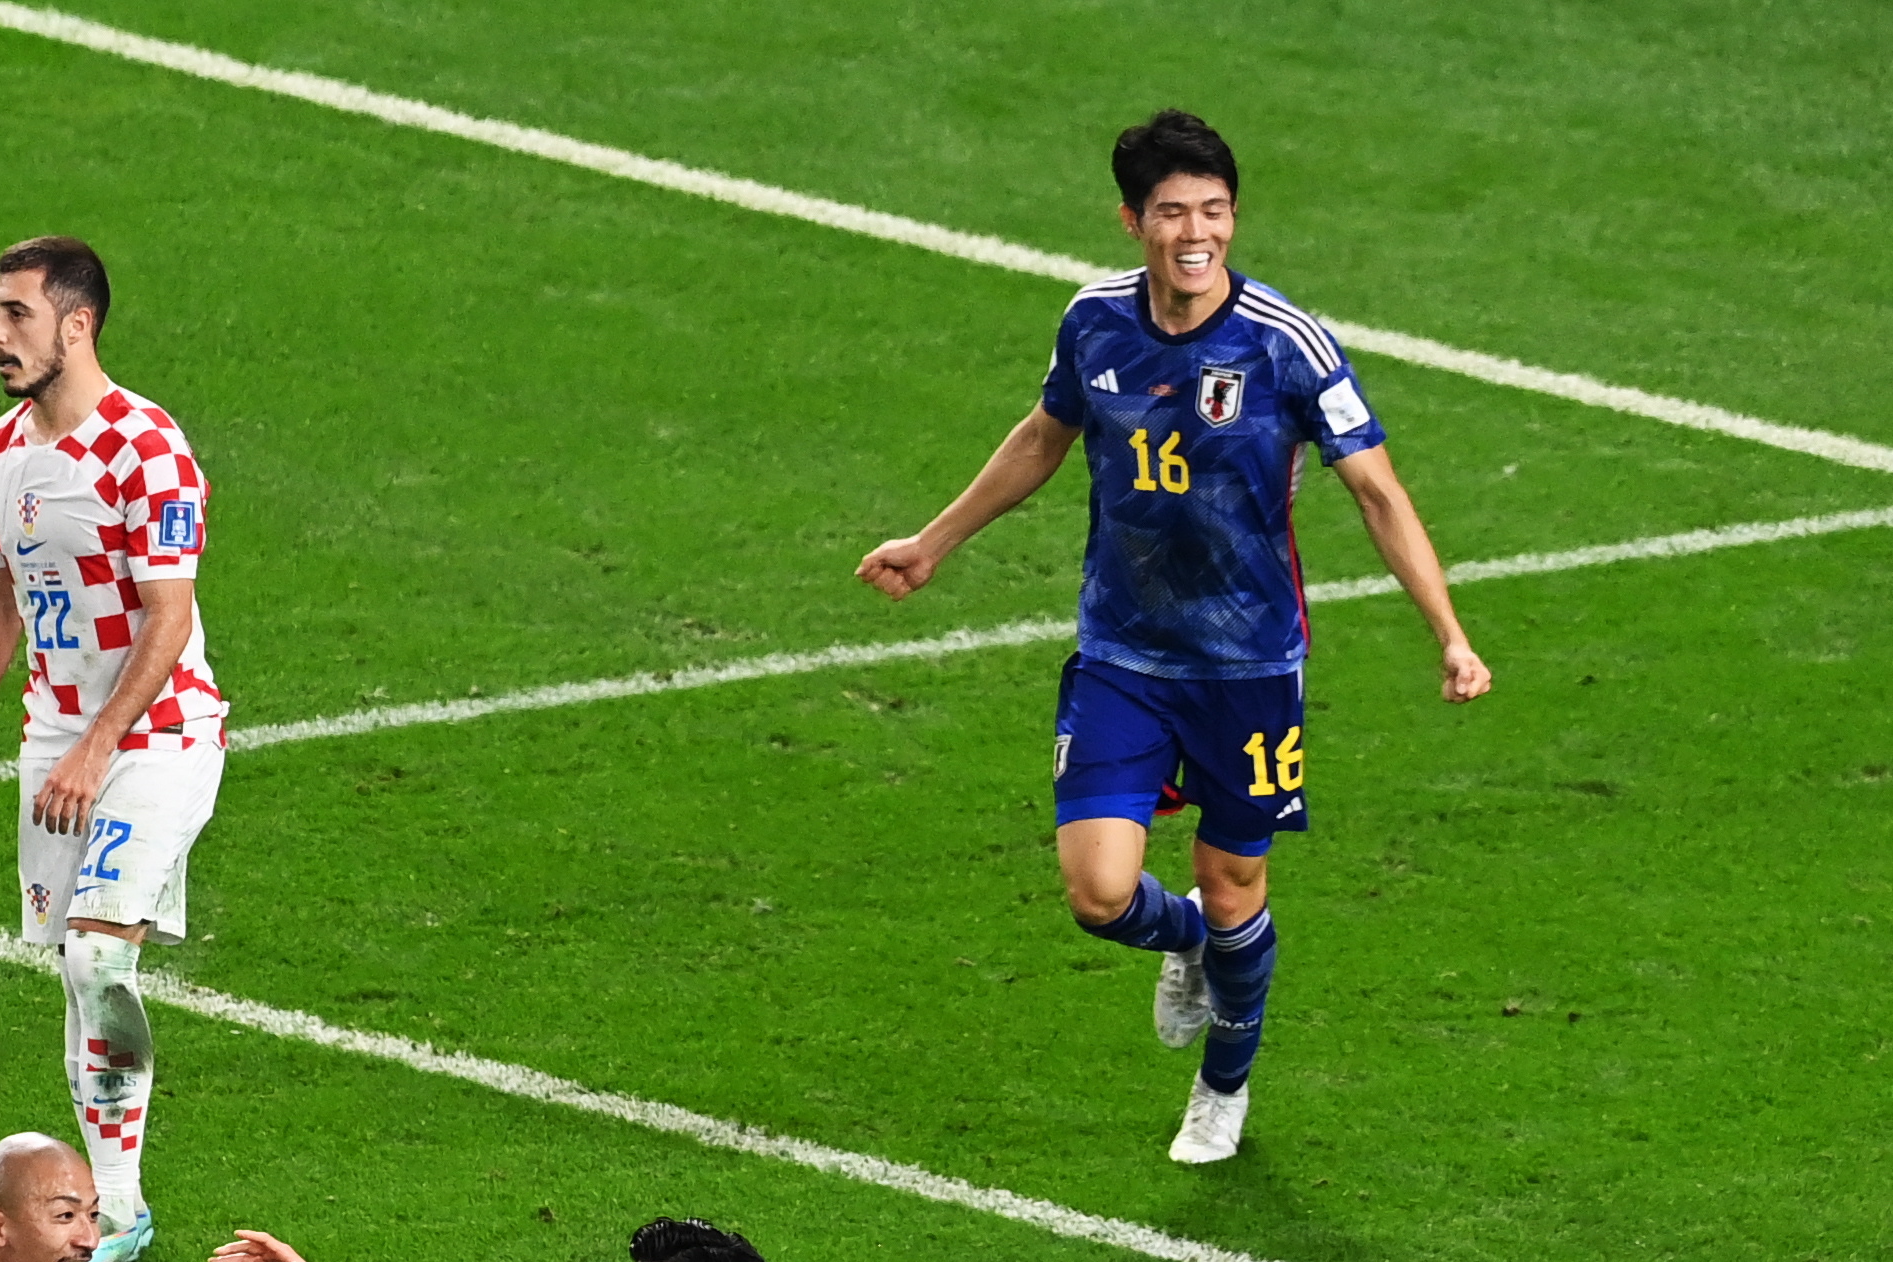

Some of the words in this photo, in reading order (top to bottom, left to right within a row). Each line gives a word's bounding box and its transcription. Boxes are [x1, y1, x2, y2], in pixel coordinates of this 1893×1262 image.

[1128, 428, 1190, 494] 16
[27, 590, 80, 649] 22
[1243, 725, 1304, 797] 16
